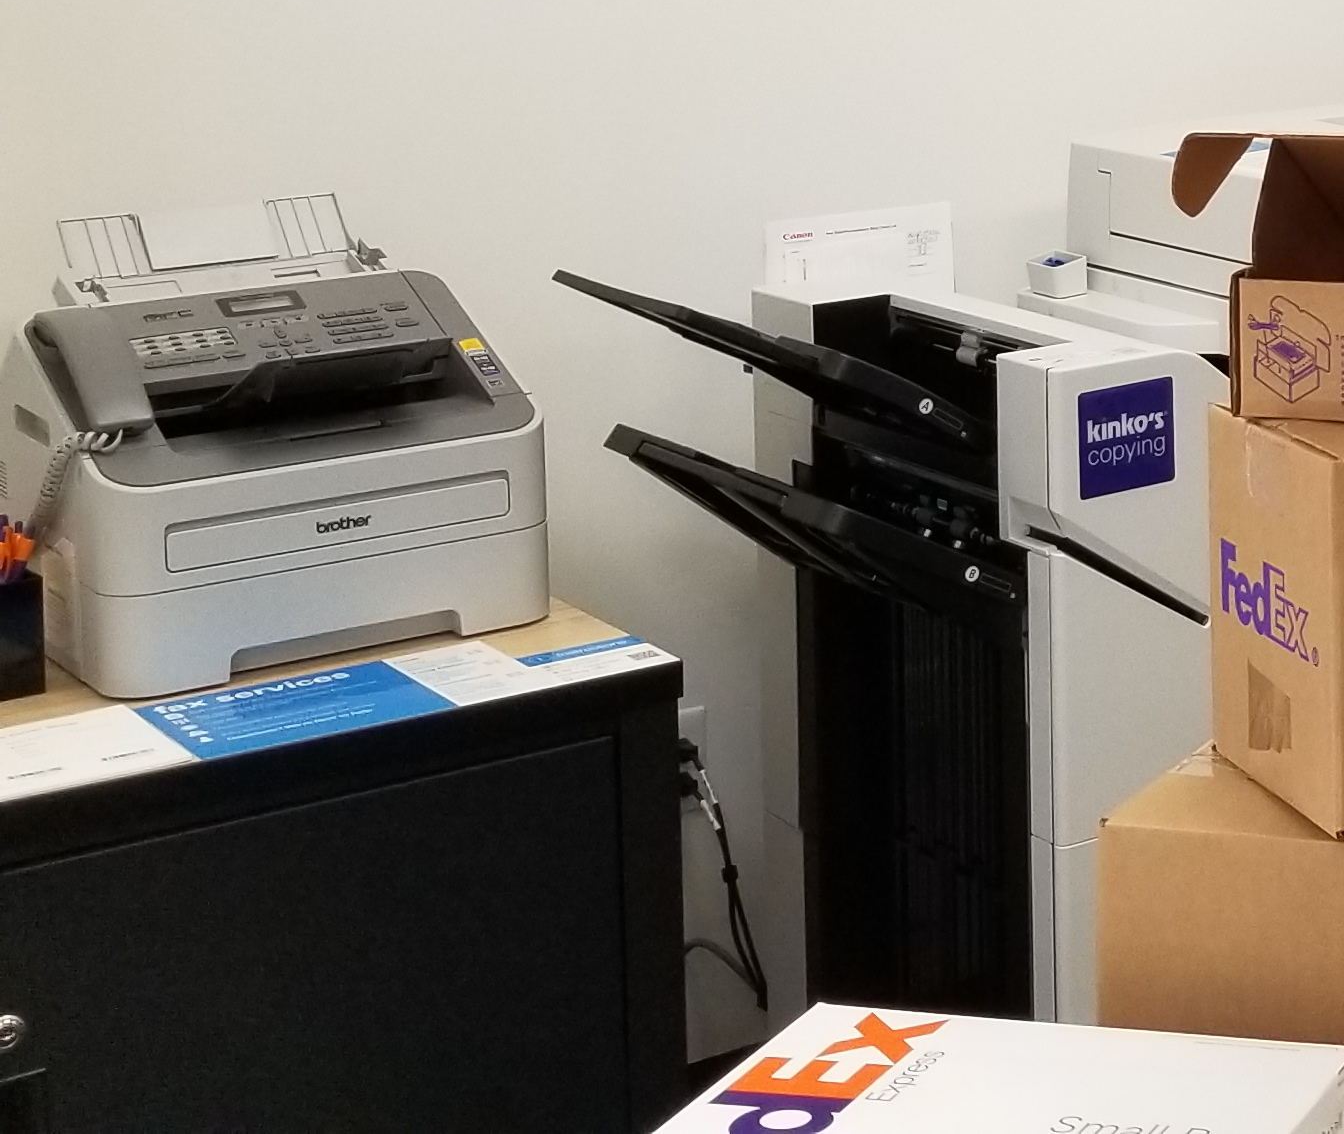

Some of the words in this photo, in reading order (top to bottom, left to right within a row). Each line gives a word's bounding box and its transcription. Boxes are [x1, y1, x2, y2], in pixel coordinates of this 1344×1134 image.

[782, 231, 814, 241] Canon
[1086, 411, 1165, 443] kinko's
[1088, 435, 1166, 466] copying
[315, 513, 372, 534] brother
[152, 699, 207, 715] fax
[215, 670, 350, 703] services
[865, 1050, 948, 1104] Express
